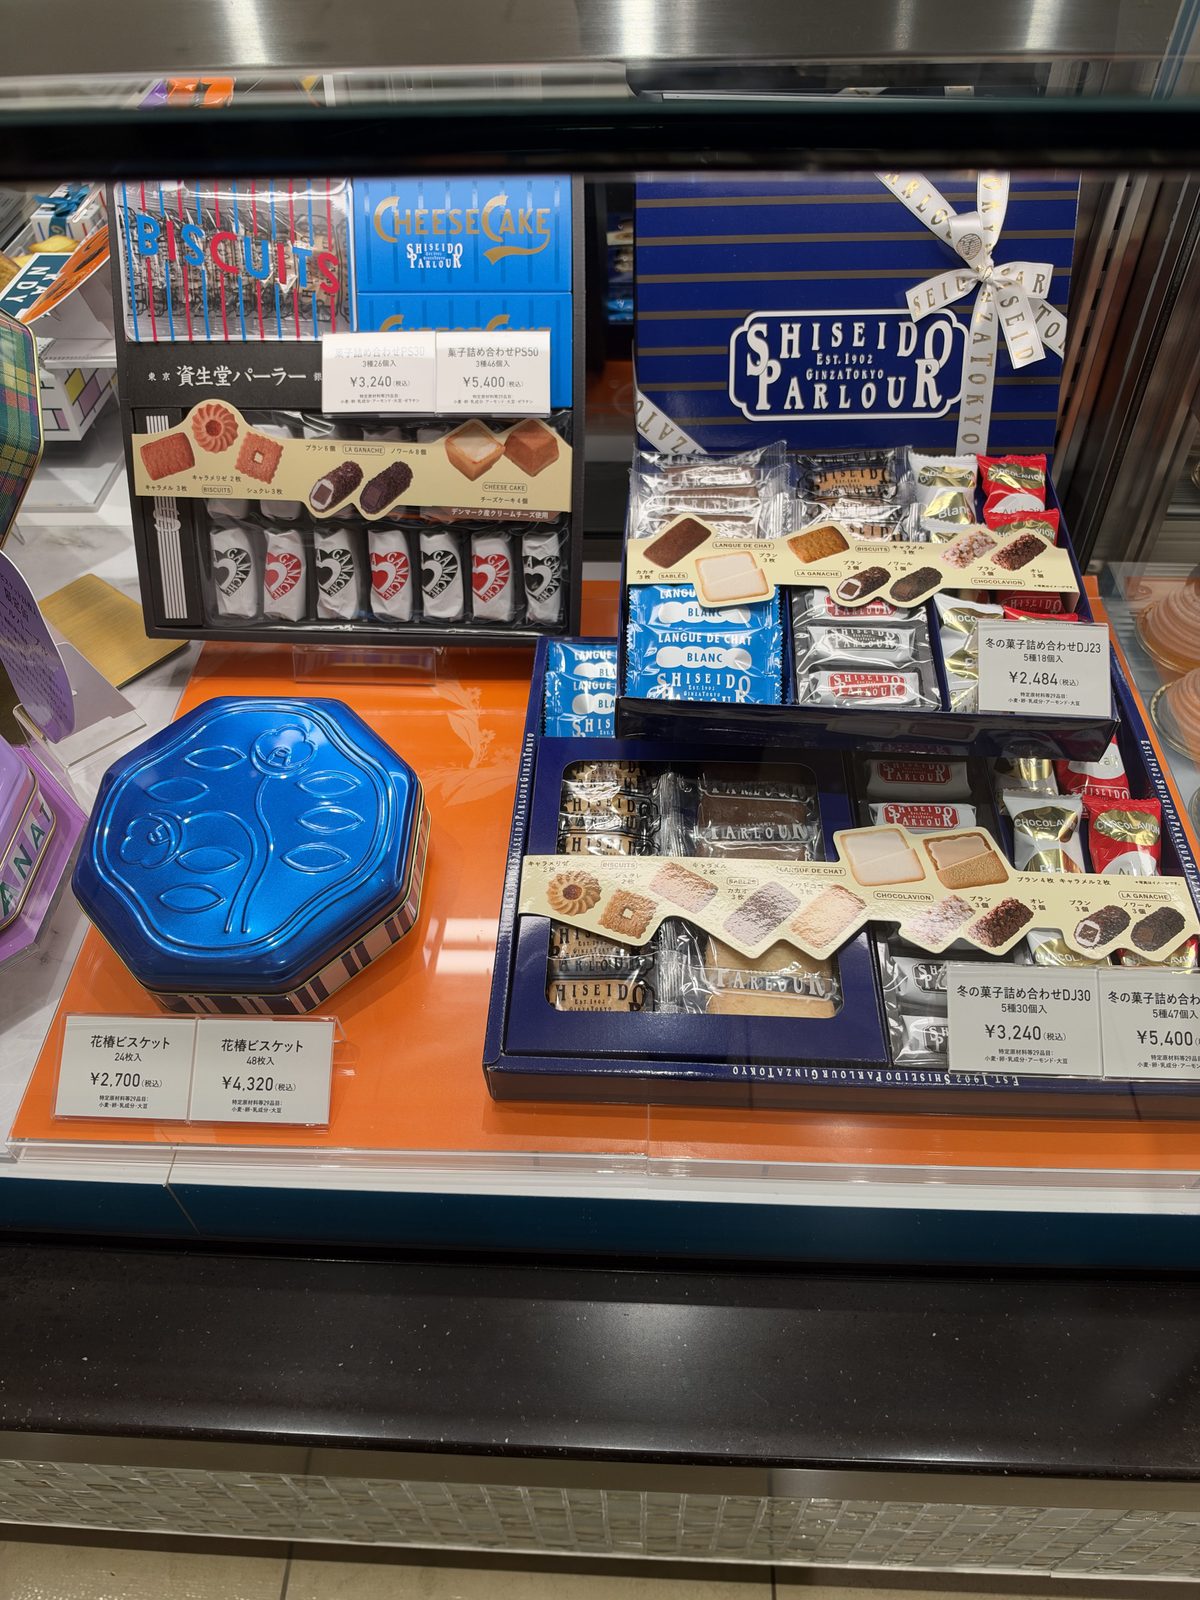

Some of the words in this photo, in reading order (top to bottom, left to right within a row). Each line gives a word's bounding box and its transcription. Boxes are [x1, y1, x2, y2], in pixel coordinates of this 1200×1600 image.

[136, 213, 341, 294] BISCUITS
[447, 346, 540, 358] 菓子詰め合わせPS50
[746, 320, 953, 376] SHISEIDO
[176, 364, 307, 387] 資生堂パーラー
[755, 358, 943, 411] PARLOUR
[354, 446, 384, 454] GANACHE
[660, 588, 697, 600] LANGU
[658, 632, 702, 643] LANGUE
[706, 635, 720, 644] DE
[723, 635, 752, 646] CHAT
[985, 637, 1102, 654] 冬の菓子詰め合わせDJ23
[687, 652, 723, 663] BLANC
[1023, 653, 1064, 663] 5種18個入
[656, 672, 751, 694] SHISEIDO
[876, 892, 931, 901] CHOCOLAVION
[1121, 892, 1132, 900] LA
[1133, 893, 1170, 901] GANACHE
[957, 985, 1091, 1002] 冬の菓子詰め合わせDJ30
[1001, 1003, 1048, 1014] 5種30個入
[1152, 1008, 1199, 1020] 5種47個入
[90, 1034, 170, 1050] 花椿ビスケット
[221, 1038, 304, 1053] 花椿ビスケット
[114, 1052, 142, 1062] 24枚入
[246, 1056, 275, 1066] 48枚入
